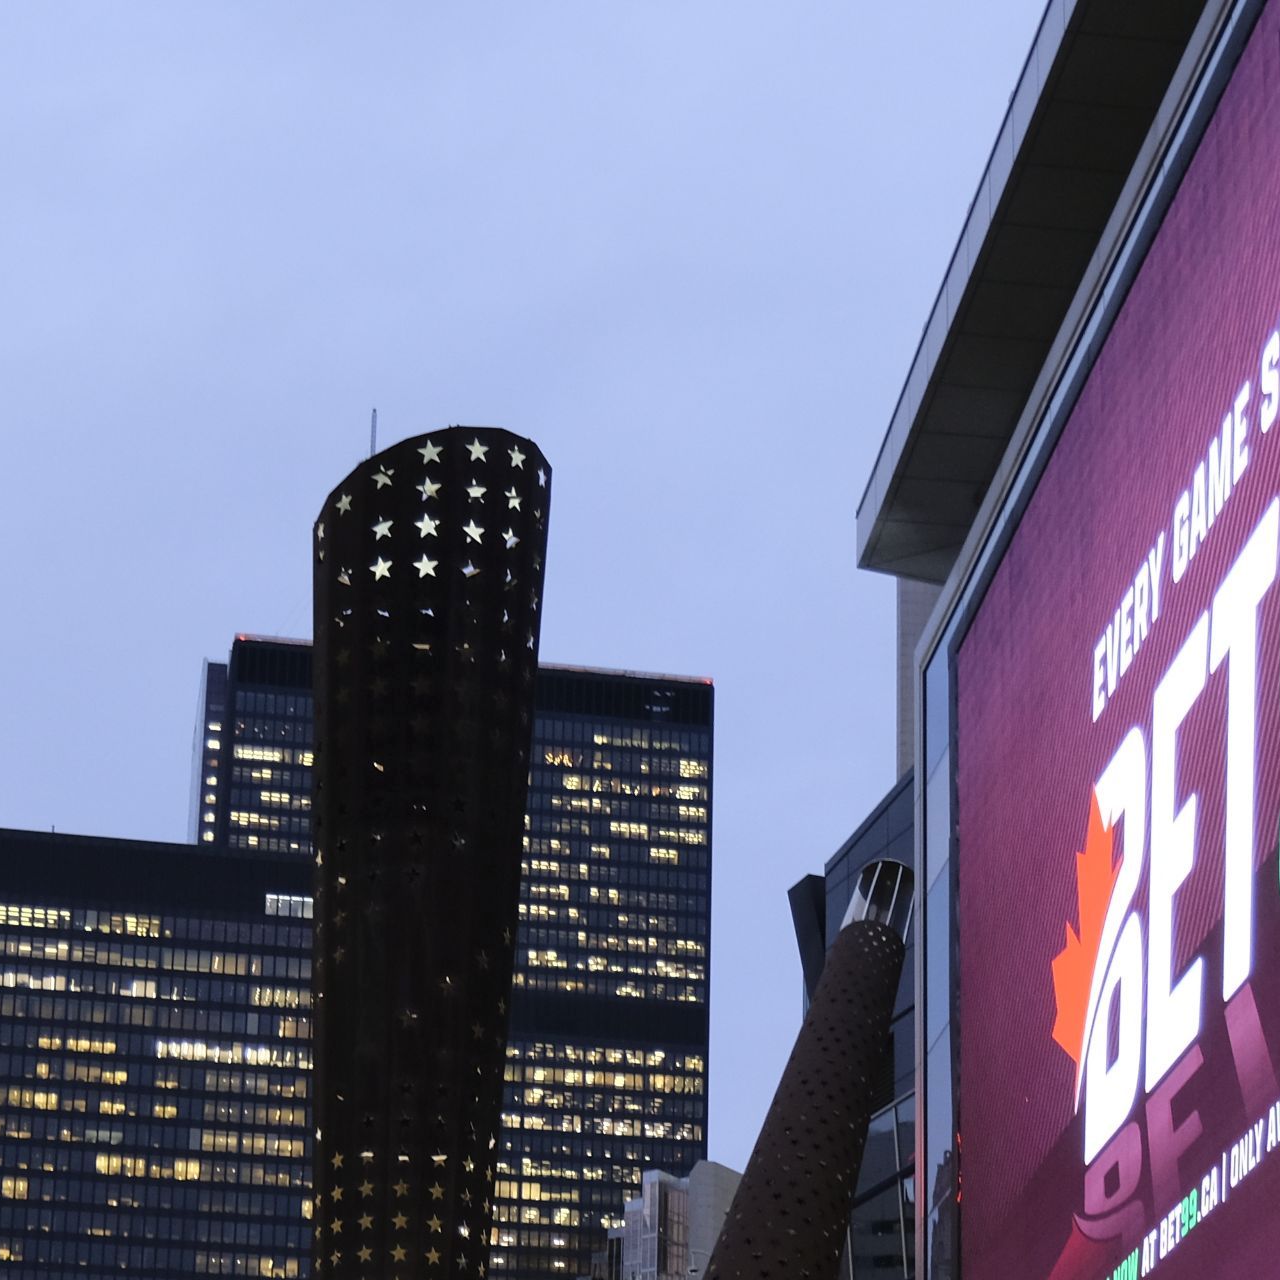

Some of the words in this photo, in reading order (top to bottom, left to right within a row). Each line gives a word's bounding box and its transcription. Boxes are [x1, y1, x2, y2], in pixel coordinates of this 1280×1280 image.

[1092, 531, 1164, 723] EVERY
[1172, 380, 1250, 584] GAME
[1141, 1229, 1157, 1277] AT
[1159, 1166, 1218, 1259] BET99.CA
[1230, 1118, 1264, 1188] ONLY
